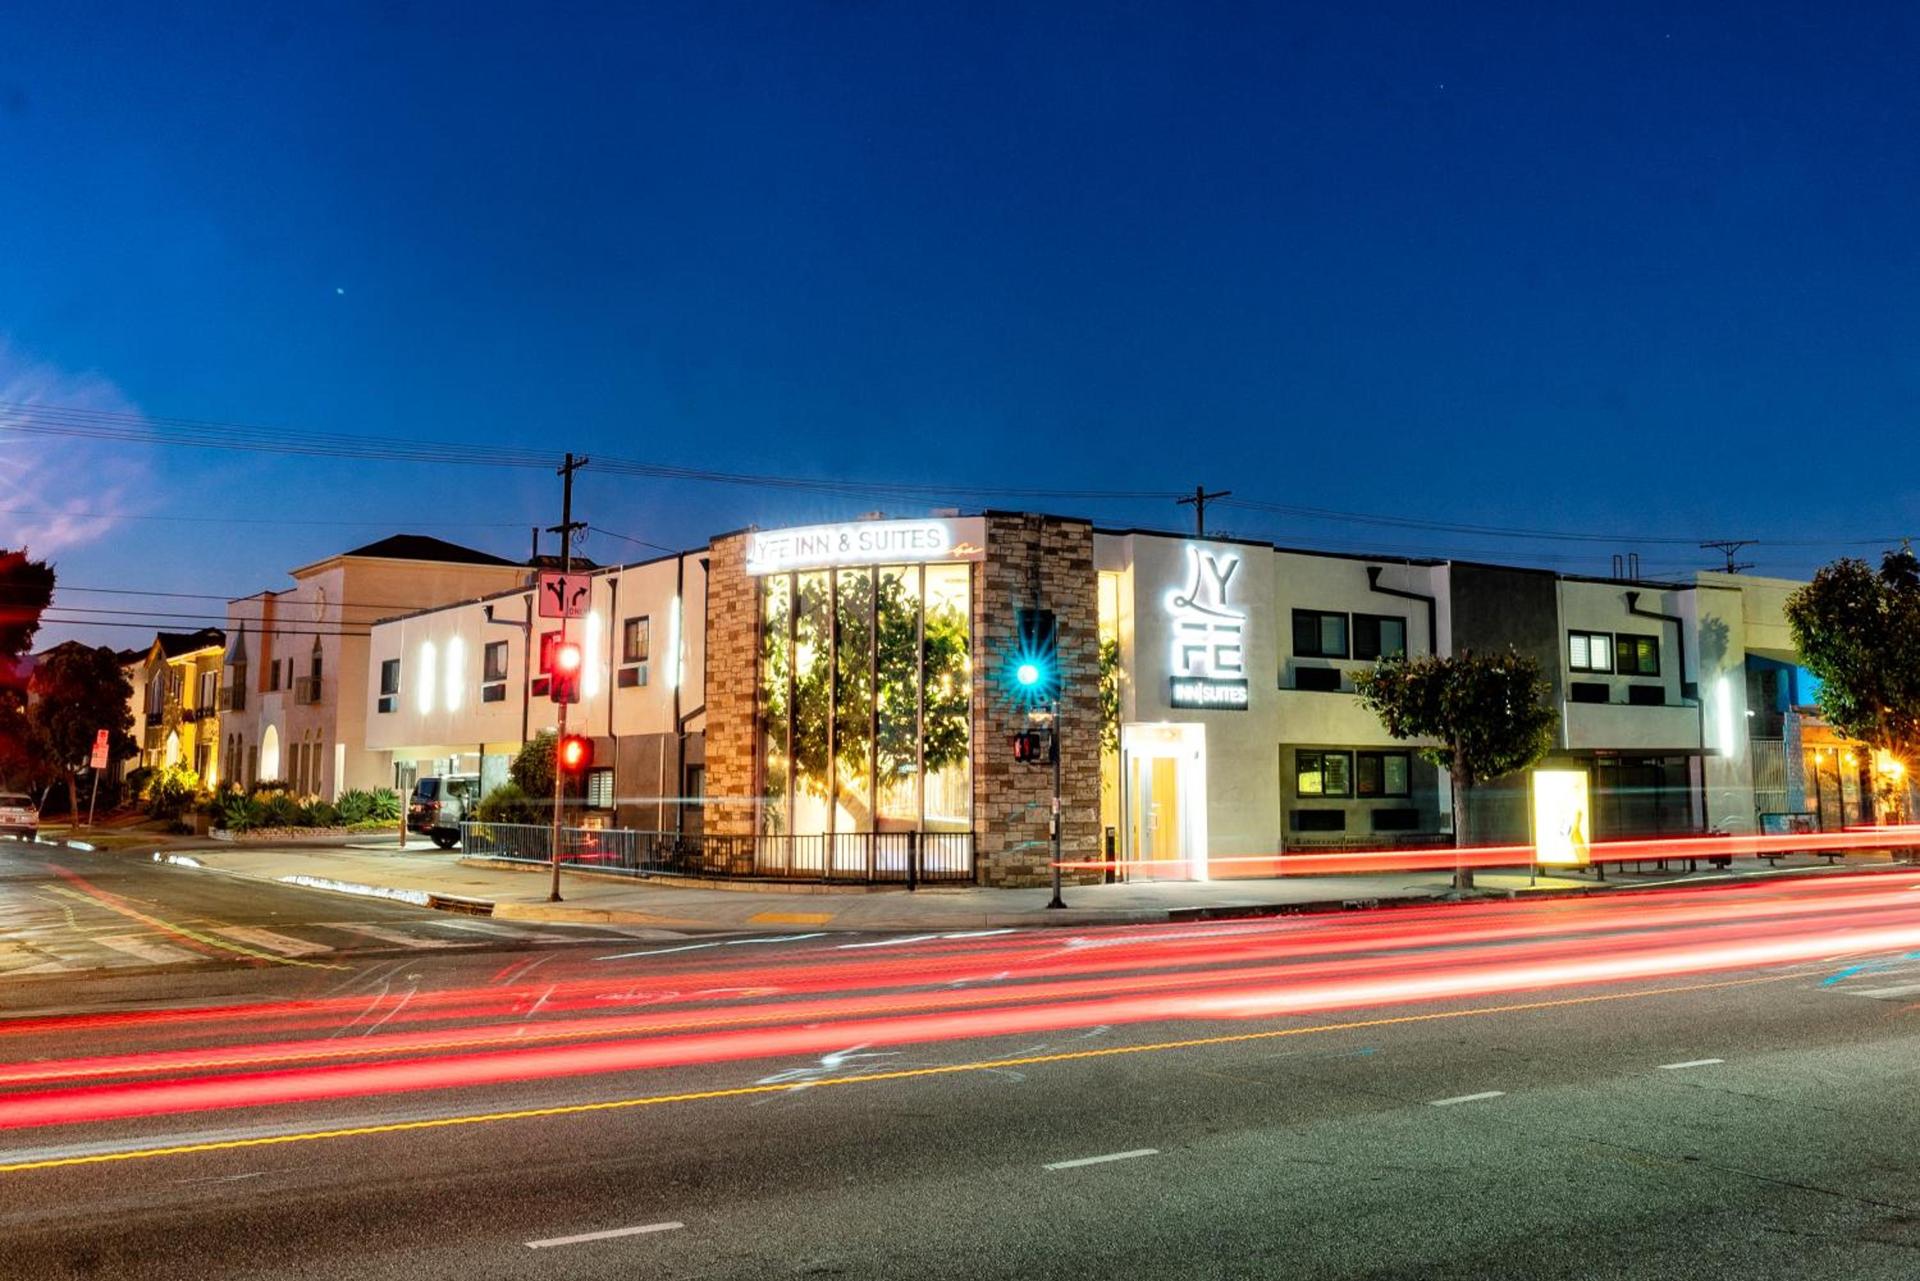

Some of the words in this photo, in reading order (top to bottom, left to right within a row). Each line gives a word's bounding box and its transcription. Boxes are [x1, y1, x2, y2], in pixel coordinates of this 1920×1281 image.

[795, 535, 830, 556] INN
[838, 532, 850, 552] &
[859, 528, 941, 550] SUITES
